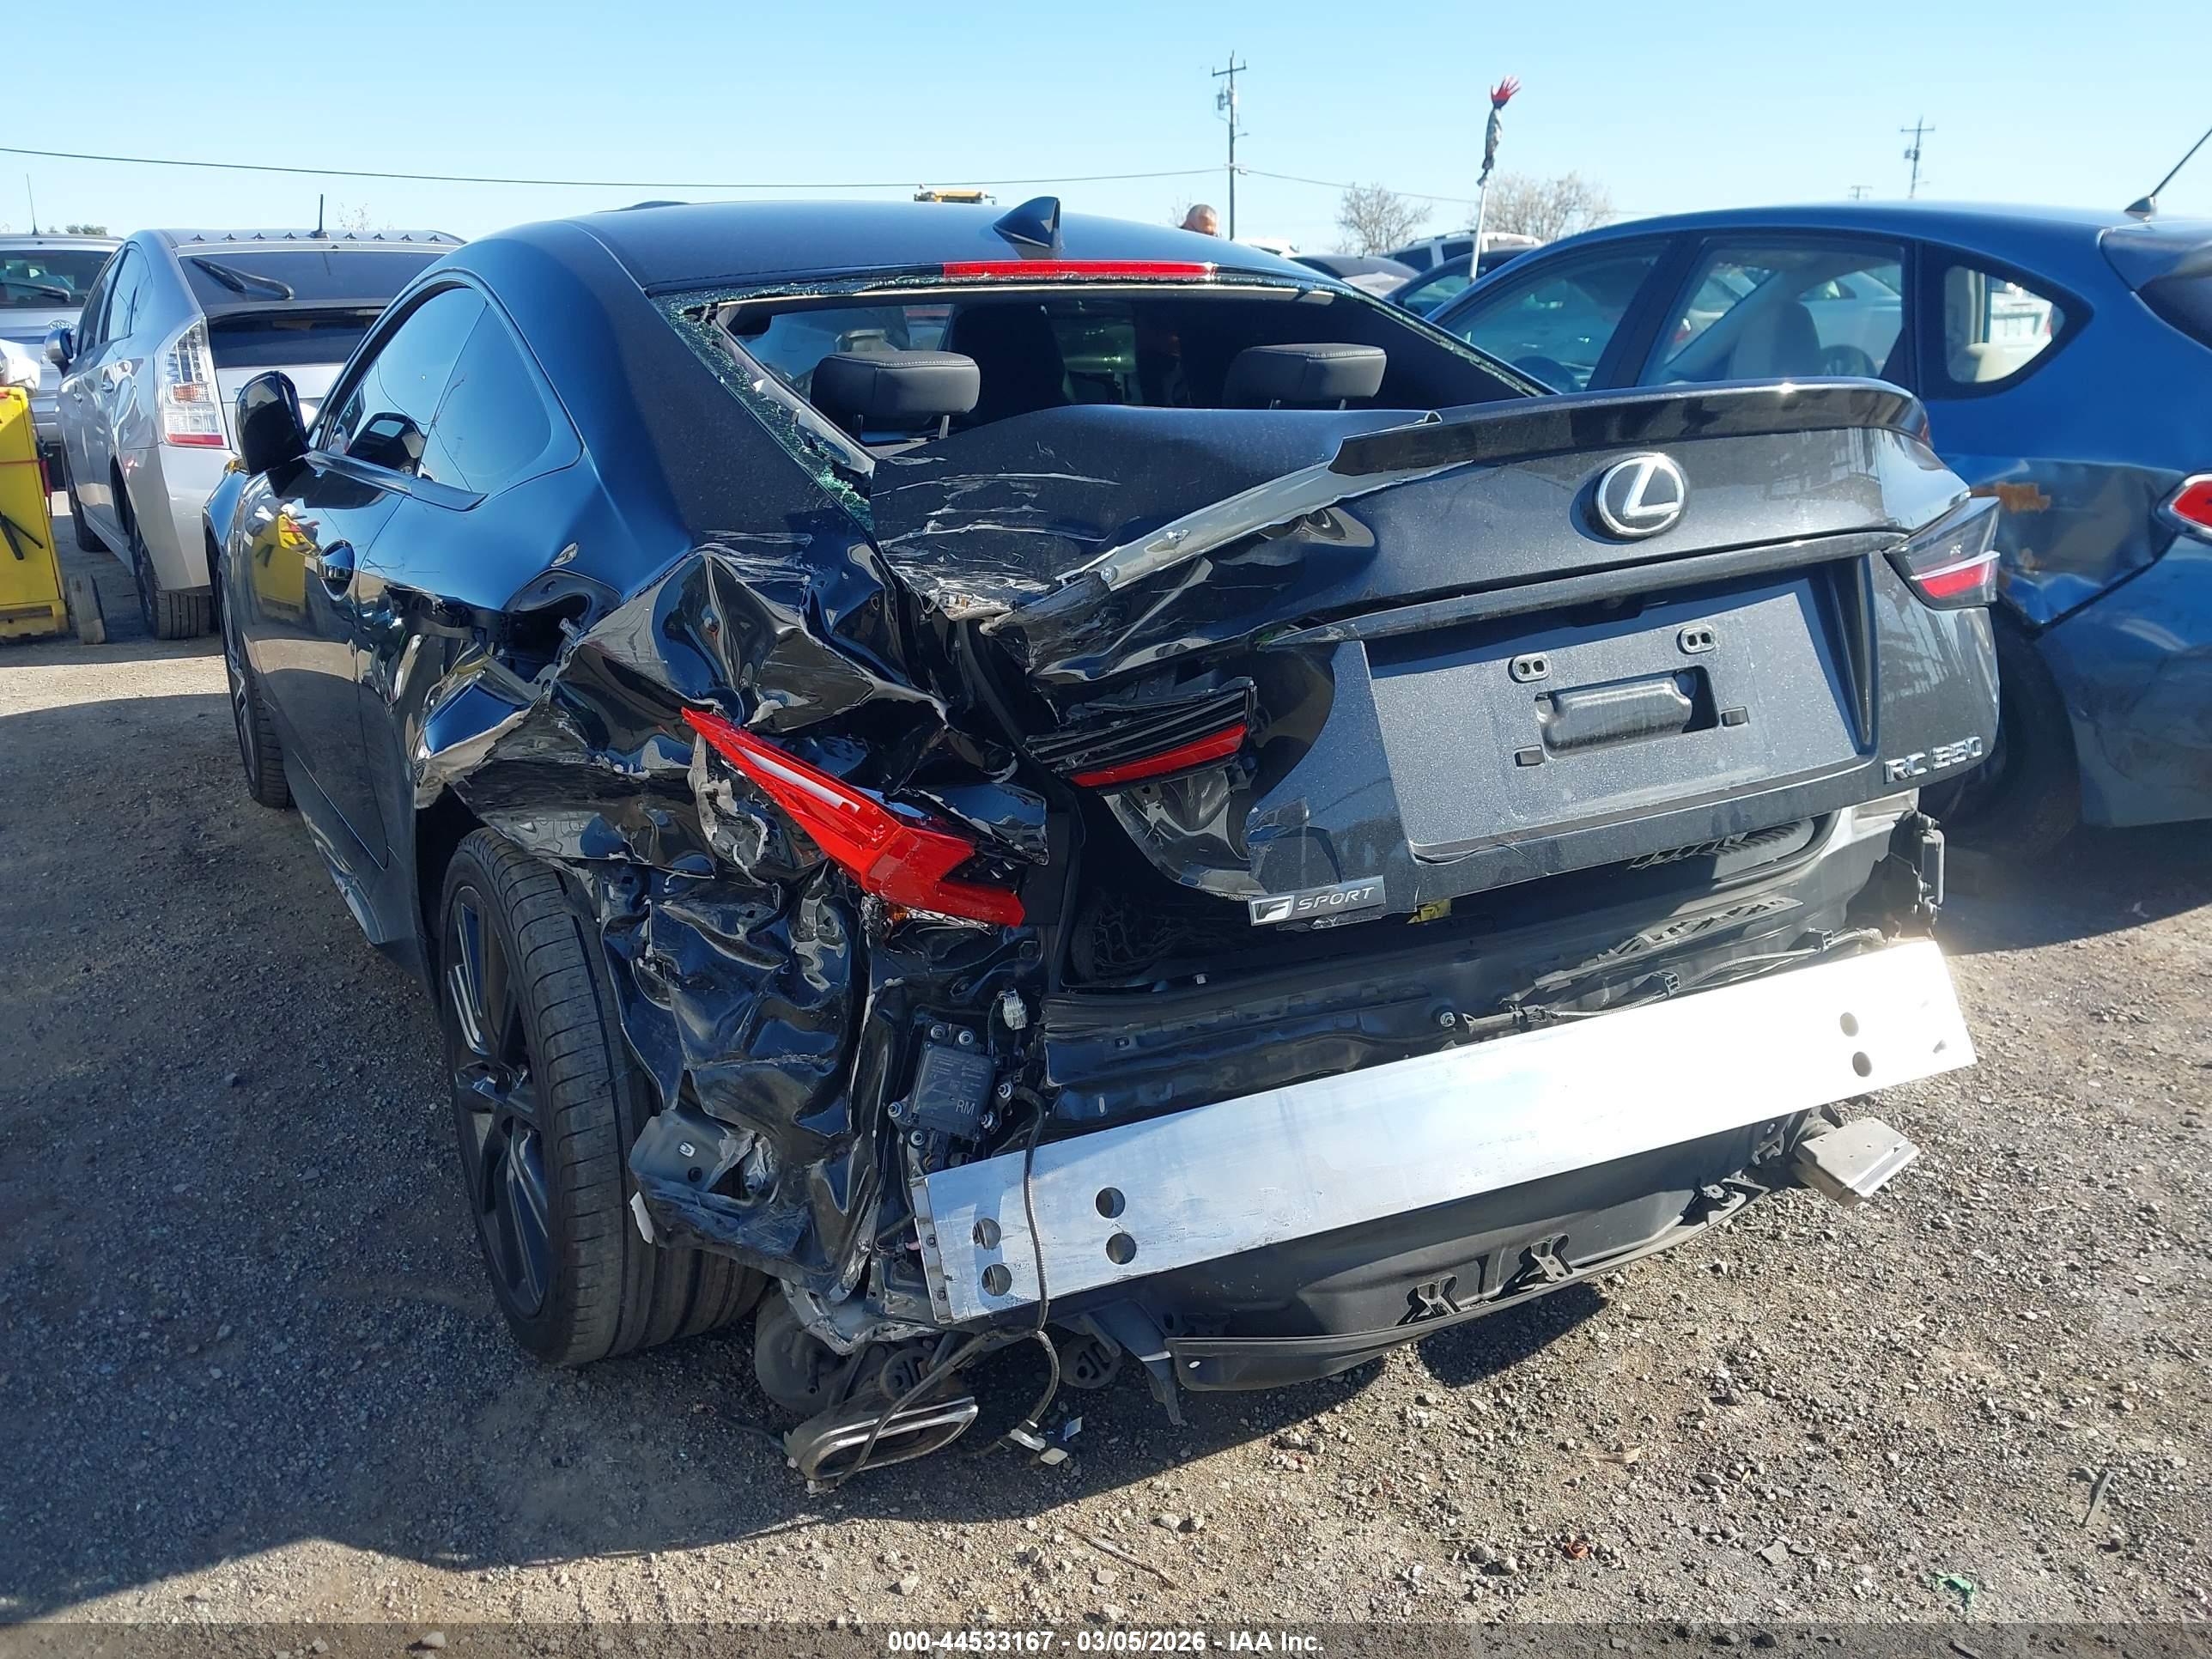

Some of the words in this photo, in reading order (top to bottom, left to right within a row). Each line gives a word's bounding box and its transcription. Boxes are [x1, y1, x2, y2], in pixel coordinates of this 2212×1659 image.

[1885, 752, 1927, 782] RC
[1931, 736, 1983, 769] 350
[1297, 887, 1375, 911] SPORT
[956, 1099, 975, 1116] RM
